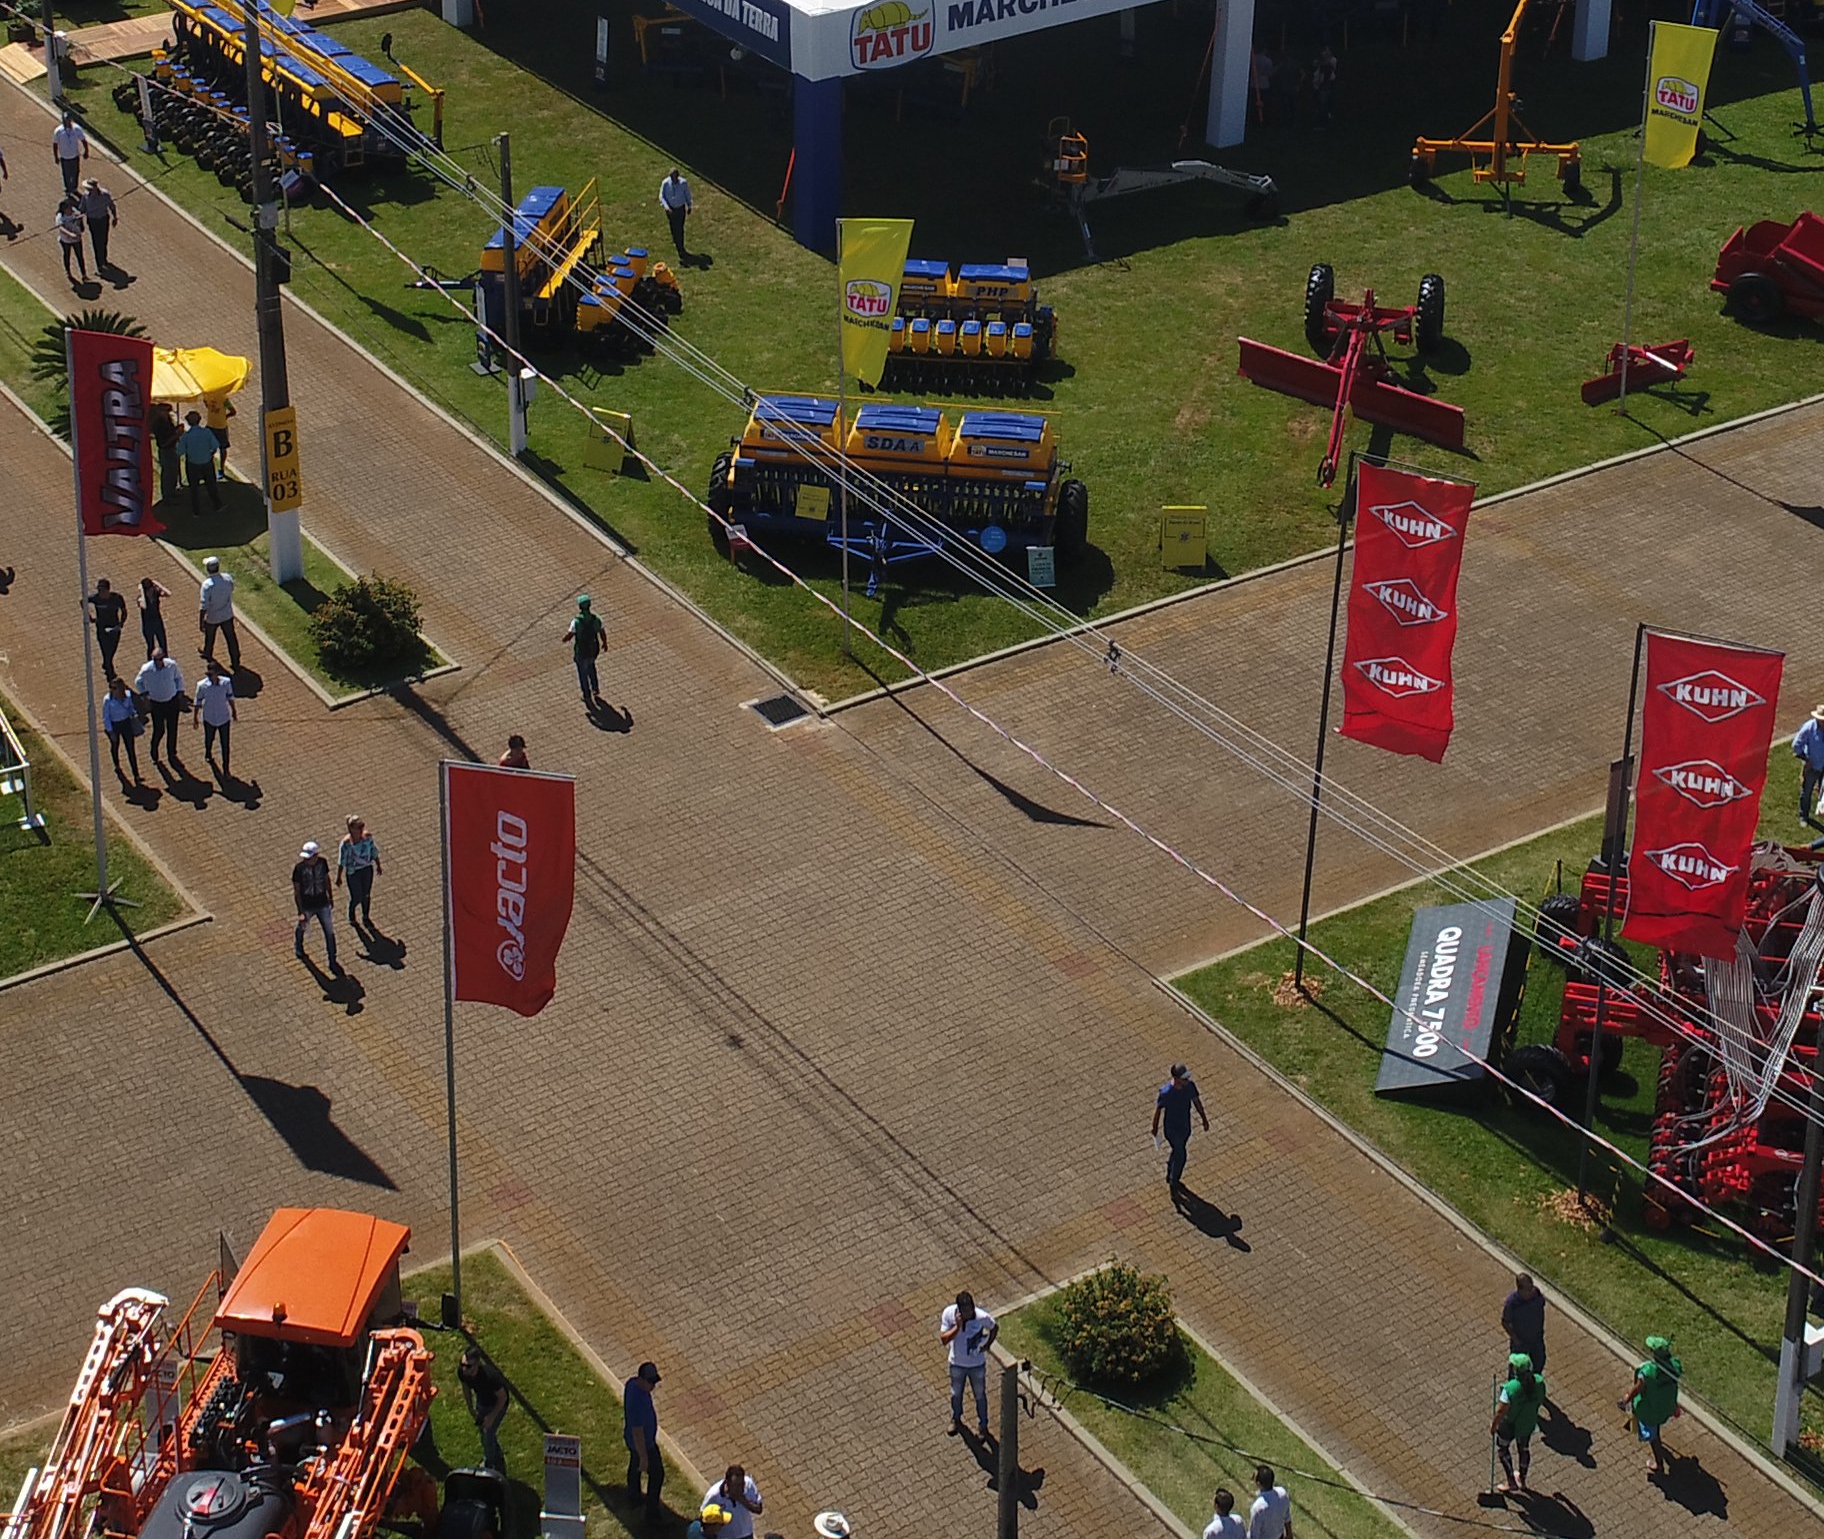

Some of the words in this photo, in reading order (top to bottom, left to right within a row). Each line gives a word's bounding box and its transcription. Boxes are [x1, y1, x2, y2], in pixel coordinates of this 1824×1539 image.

[742, 2, 780, 43] TERRA
[854, 23, 932, 65] TATU
[1658, 90, 1695, 111] TATU
[1651, 107, 1699, 127] MARCHESAN
[848, 295, 888, 313] TATU
[977, 287, 1009, 297] PHP
[99, 358, 143, 528] VALTRA
[272, 429, 293, 459] B
[867, 436, 906, 452] SDA
[910, 441, 920, 453] A
[987, 449, 1027, 458] MARCHESAN
[270, 467, 297, 483] RUA
[271, 480, 298, 503] 03
[1381, 506, 1444, 539] KUHN
[1374, 584, 1436, 618] KUHN
[1366, 661, 1430, 693] KUHN
[1676, 681, 1750, 709] KUHN
[1669, 769, 1736, 799] KUHN
[1660, 852, 1727, 884] KUHN
[1429, 925, 1463, 1003] QUADRA
[1412, 1004, 1448, 1060] 7500
[546, 1445, 578, 1457] JACTO
